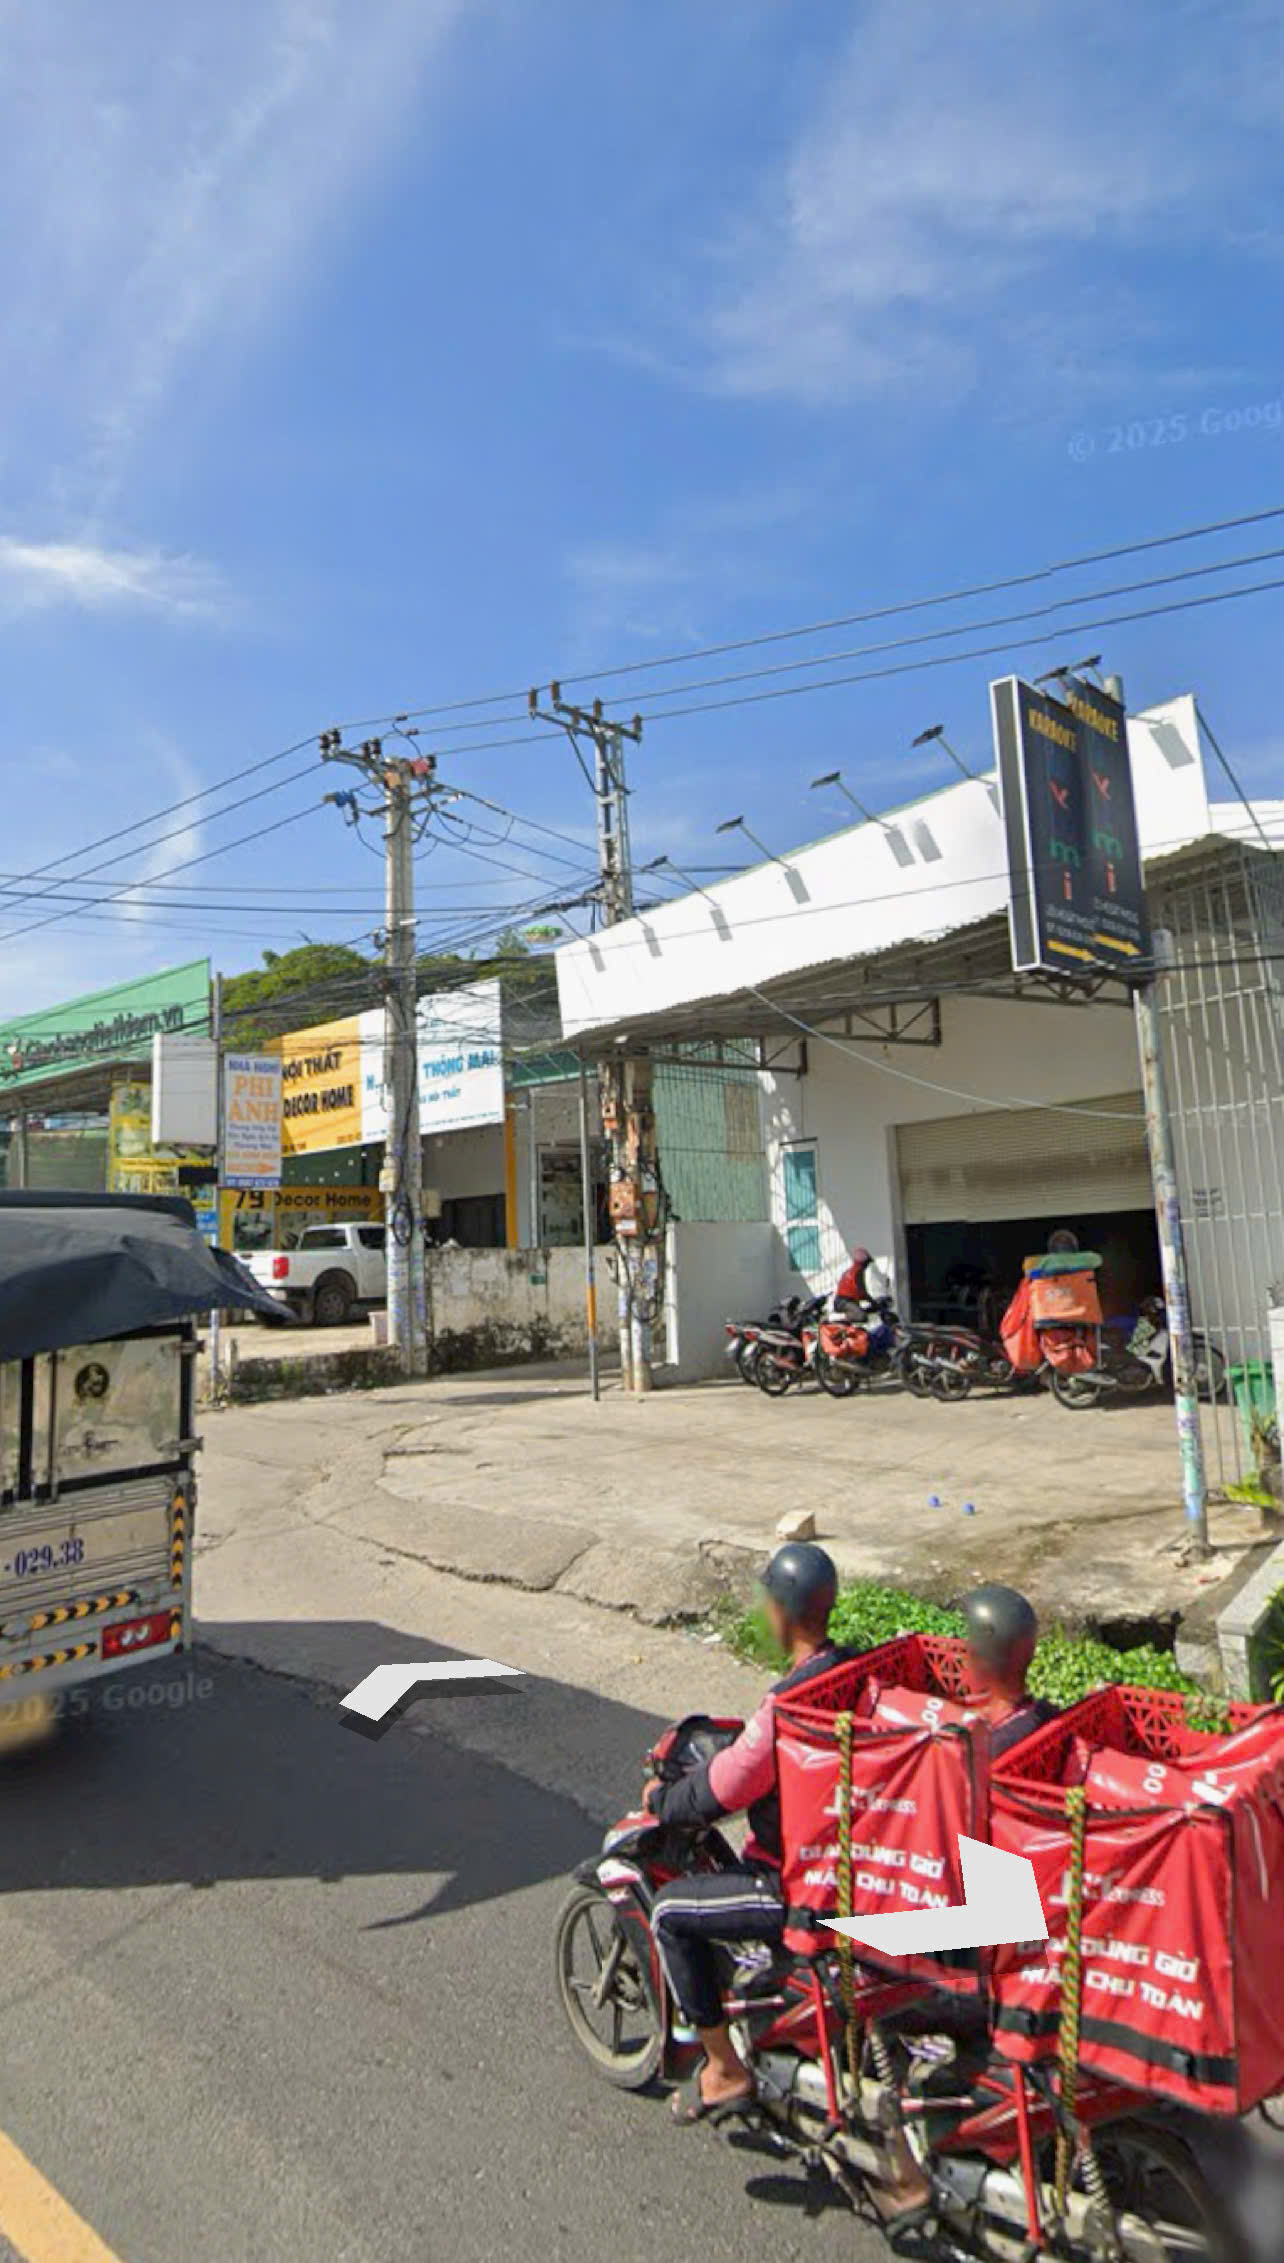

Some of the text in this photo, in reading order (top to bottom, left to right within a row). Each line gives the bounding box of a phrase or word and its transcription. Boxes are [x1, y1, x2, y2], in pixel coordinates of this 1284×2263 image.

[233, 1075, 273, 1098] PHI
[282, 1084, 355, 1120] DECOR HOME
[236, 1190, 265, 1209] 79
[326, 1192, 372, 1207] Home
